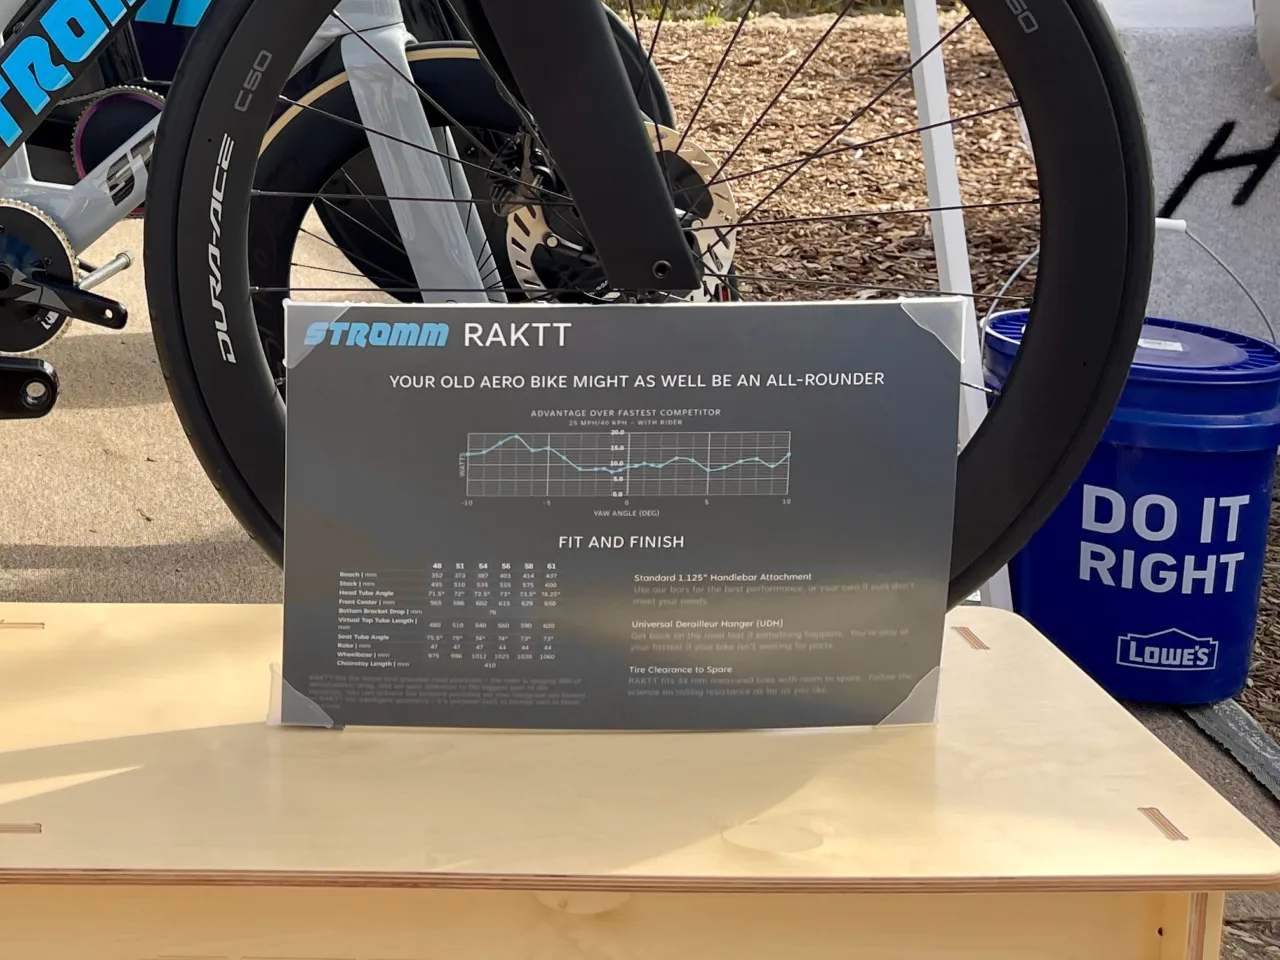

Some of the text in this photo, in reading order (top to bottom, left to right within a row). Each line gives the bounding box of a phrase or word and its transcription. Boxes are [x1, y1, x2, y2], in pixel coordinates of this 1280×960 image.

[234, 49, 272, 112] C50
[208, 132, 235, 364] DURA-ACE
[303, 321, 572, 348] STROMM RAKTT
[390, 372, 885, 388] YOUR OLD AERO BIKE MIGHT AS WELL BE AN ALL-ROUNDER
[530, 408, 722, 418] ADVANTAGE OVER FASTEST COMPETITOR
[639, 509, 660, 518] (DEG)
[1081, 483, 1250, 544] DO IT
[558, 535, 685, 550] FIT AND FINISH
[455, 562, 465, 570] 51
[478, 562, 488, 570] 54
[547, 562, 557, 570] 61
[1079, 539, 1245, 594] RIGHT
[634, 574, 676, 582] Standard
[710, 573, 757, 581] Handlebar
[760, 573, 812, 581] Attachment
[631, 619, 784, 630] Universal Derailleur Hanger (UDH)
[629, 666, 733, 675] Tire Clearance to Spare
